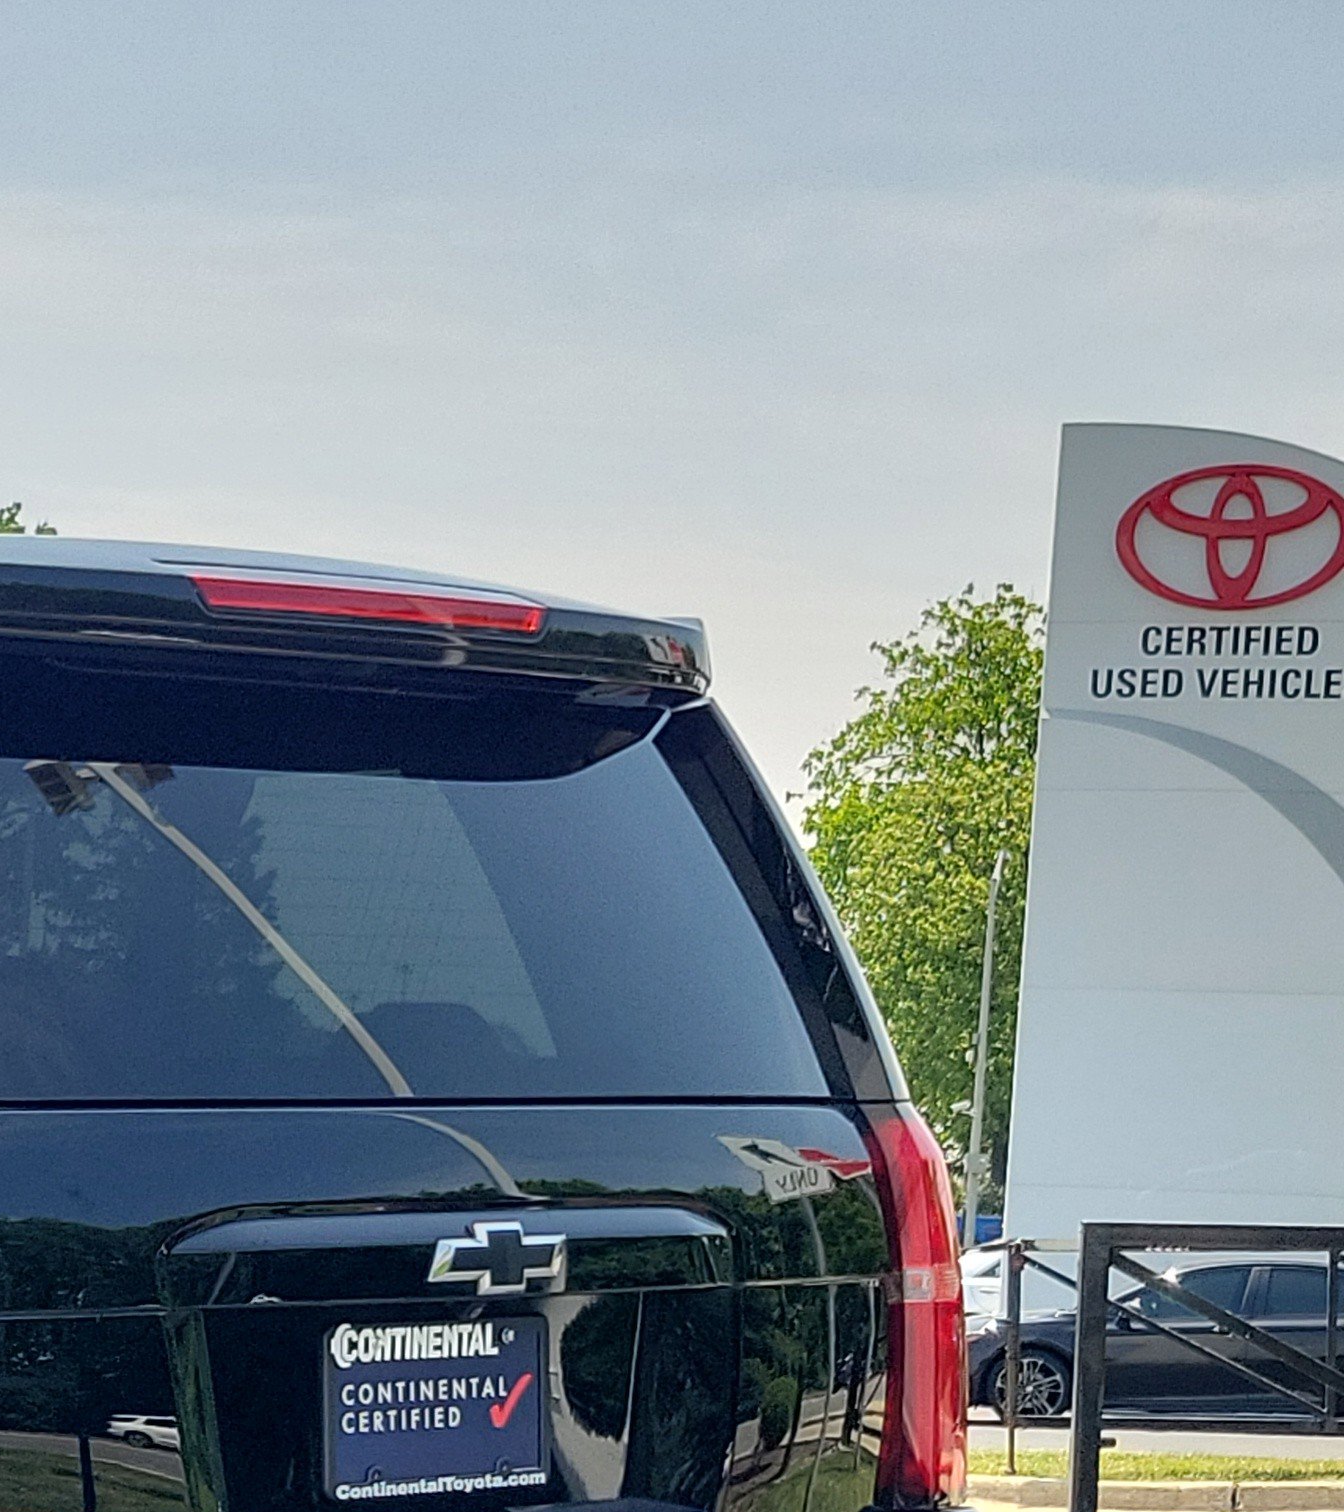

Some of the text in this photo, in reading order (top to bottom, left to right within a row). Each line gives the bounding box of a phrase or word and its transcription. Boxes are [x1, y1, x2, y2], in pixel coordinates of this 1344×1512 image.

[1141, 625, 1320, 657] CERTIFIED
[1090, 668, 1343, 699] USED VEHICLE
[330, 1322, 499, 1368] CONTINENTAL
[341, 1374, 509, 1406] CONTINENTAL
[341, 1406, 461, 1434] CERTIFIED
[335, 1470, 547, 1500] ContinentalToyota.com
